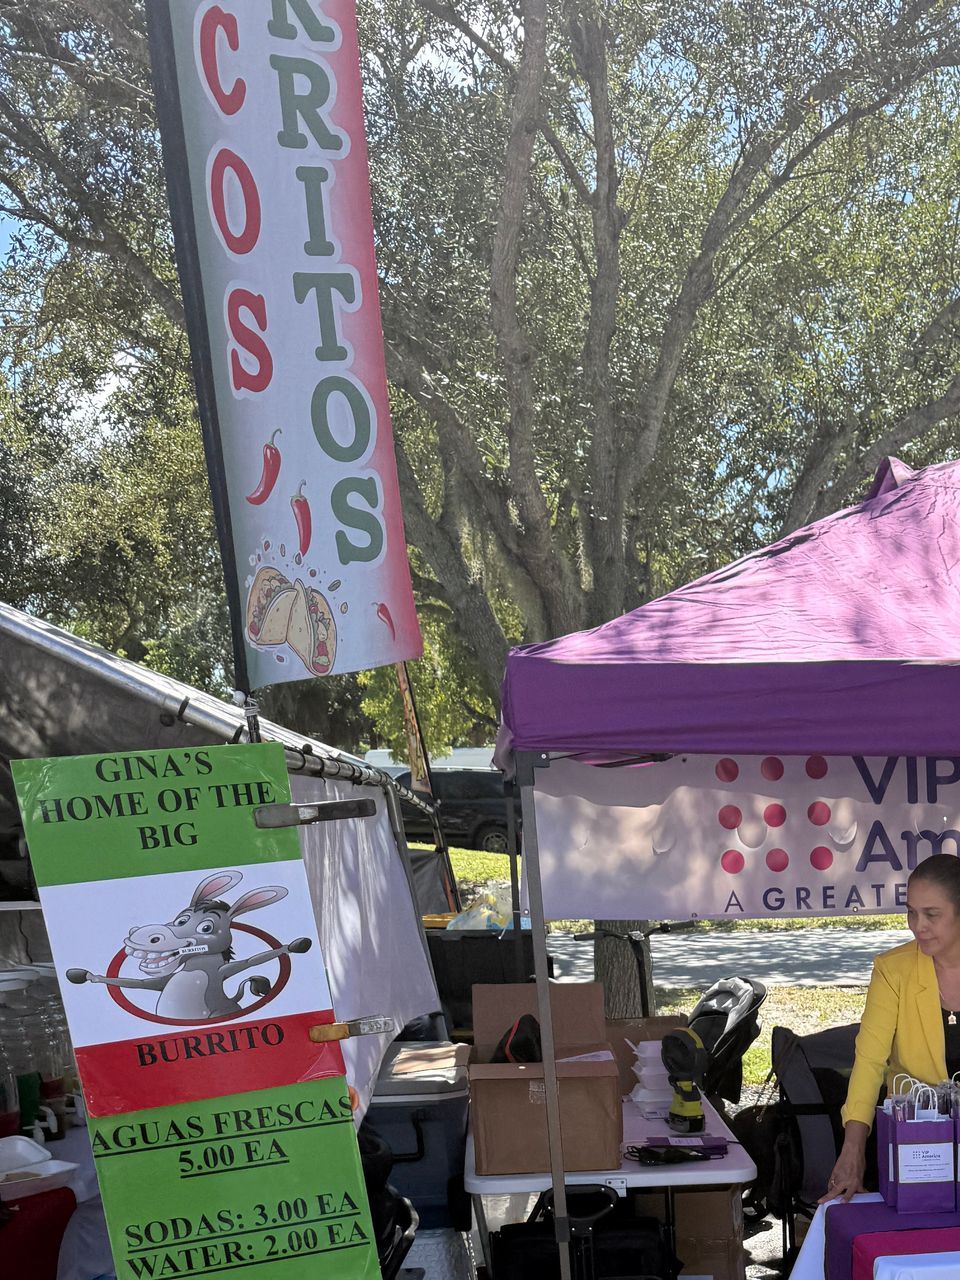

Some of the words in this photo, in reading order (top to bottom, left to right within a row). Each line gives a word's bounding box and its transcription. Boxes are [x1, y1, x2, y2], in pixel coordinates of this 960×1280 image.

[95, 751, 213, 783] GINA'S
[39, 791, 149, 824] HOME
[157, 787, 201, 813] OF
[208, 781, 277, 809] THE
[137, 822, 199, 850] BIG
[724, 890, 744, 912] A
[762, 882, 907, 911] GREATE
[136, 1023, 284, 1067] BURRITO
[92, 1115, 204, 1152] AGUAS
[212, 1095, 354, 1135] FRESCAS
[178, 1143, 235, 1173] 5.00
[242, 1138, 288, 1163] EA
[125, 1209, 245, 1248] SODAS:
[253, 1197, 308, 1227] 3.00
[315, 1190, 360, 1216] EA
[125, 1240, 255, 1280] WATER:
[263, 1227, 318, 1257] 2.00
[325, 1220, 368, 1245] EA
